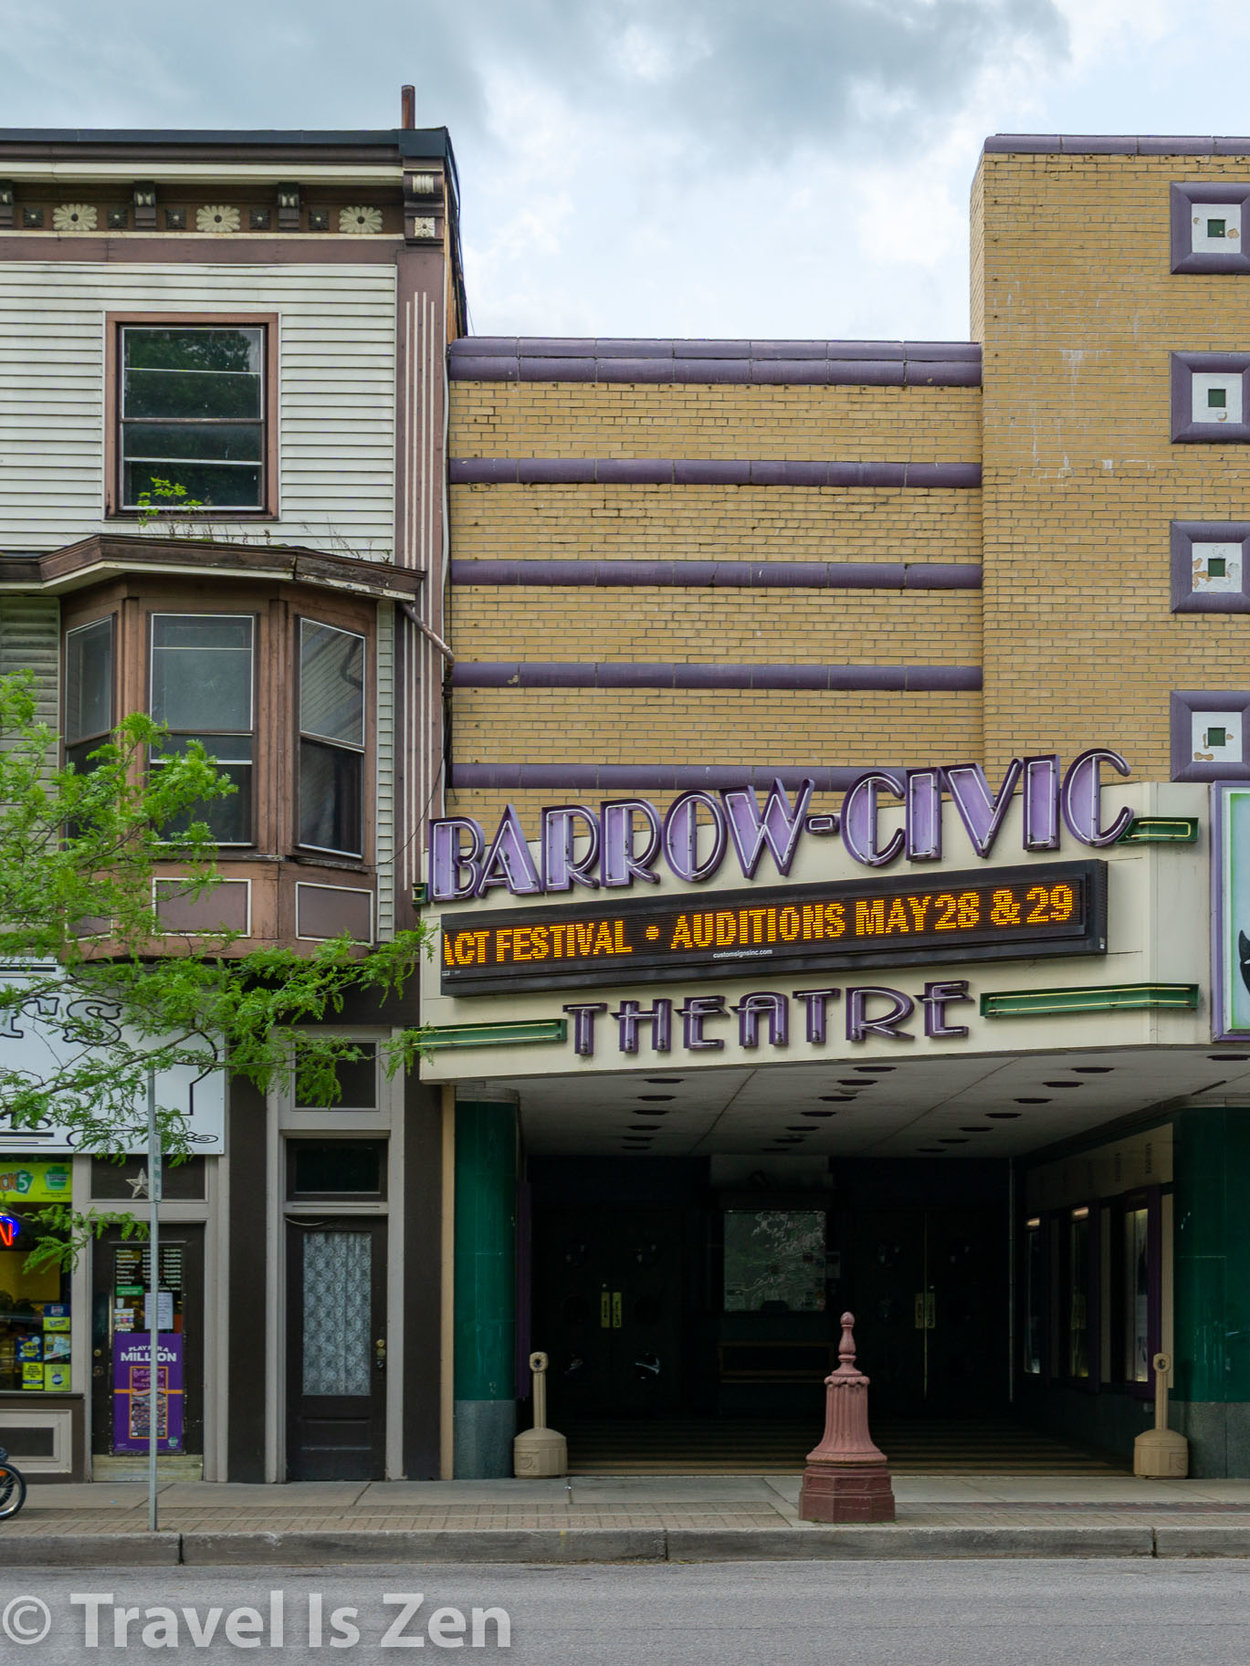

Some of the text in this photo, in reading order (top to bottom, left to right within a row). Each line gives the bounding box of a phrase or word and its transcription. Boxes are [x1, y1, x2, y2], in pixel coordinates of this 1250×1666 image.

[428, 748, 1134, 904] BARROW-CIVIC
[496, 920, 633, 962] FESTIVAL
[670, 902, 846, 950] AUDITIONS
[1026, 885, 1073, 924] 29
[562, 980, 975, 1057] THEATRE
[120, 1352, 177, 1362] MILLON
